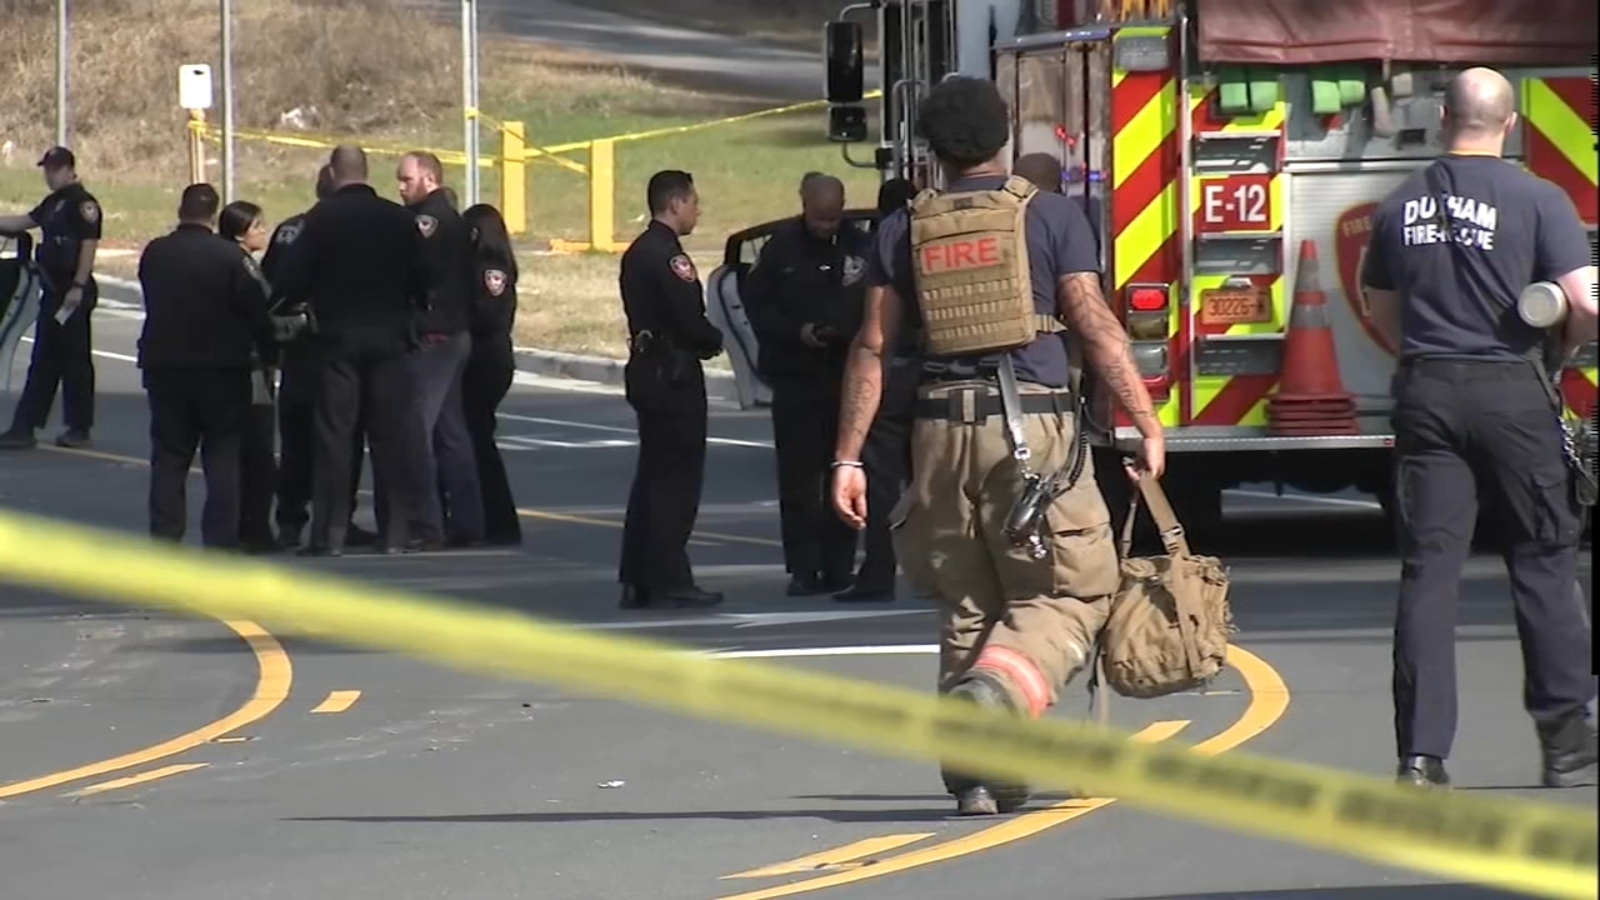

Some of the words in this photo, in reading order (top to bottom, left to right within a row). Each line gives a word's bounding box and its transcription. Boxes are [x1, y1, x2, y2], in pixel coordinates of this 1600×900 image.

[1205, 184, 1266, 222] E-12
[1404, 196, 1497, 231] DUHAM
[924, 236, 999, 272] FIRE
[1403, 224, 1494, 250] FIRE-RCUE
